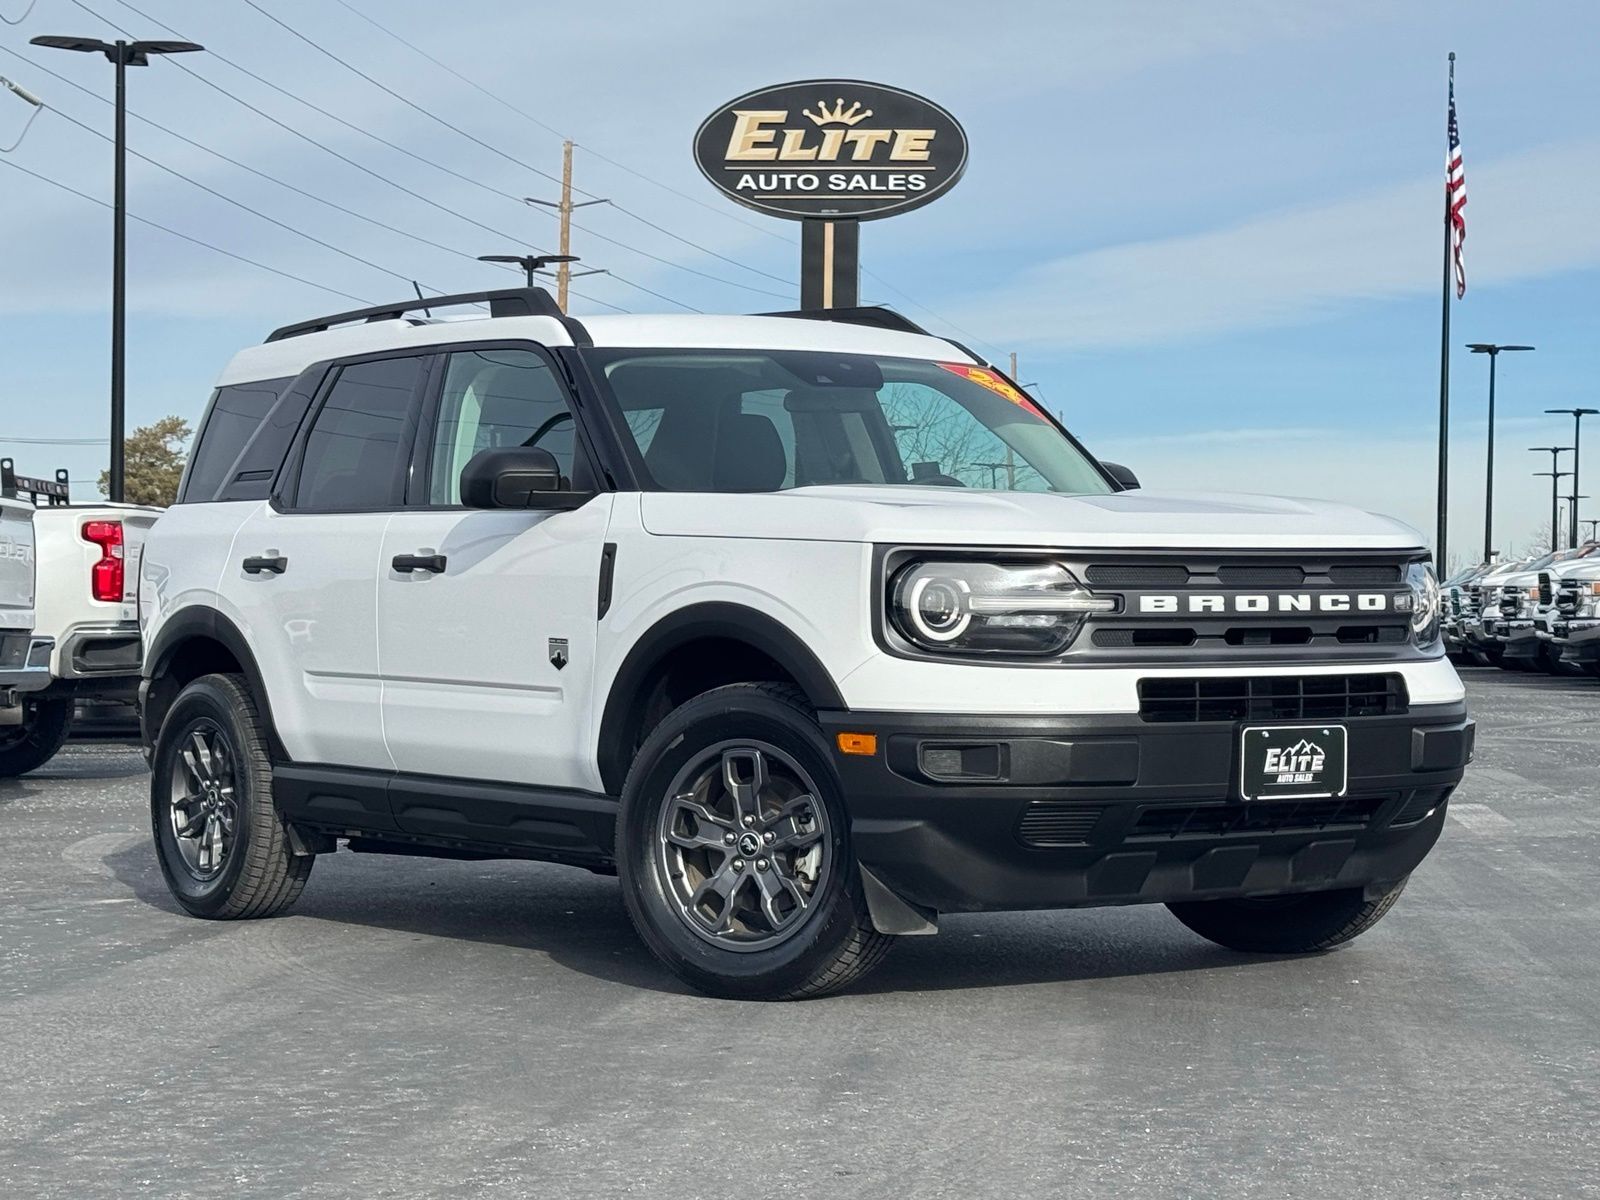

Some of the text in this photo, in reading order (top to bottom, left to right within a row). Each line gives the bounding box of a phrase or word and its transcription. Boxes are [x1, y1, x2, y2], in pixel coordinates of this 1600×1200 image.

[724, 110, 936, 161] ELITE
[736, 174, 926, 191] AUTO SALES
[1140, 594, 1386, 613] BRONCO
[1263, 748, 1325, 773] ELITE
[1276, 773, 1313, 783] AUTO SALES
